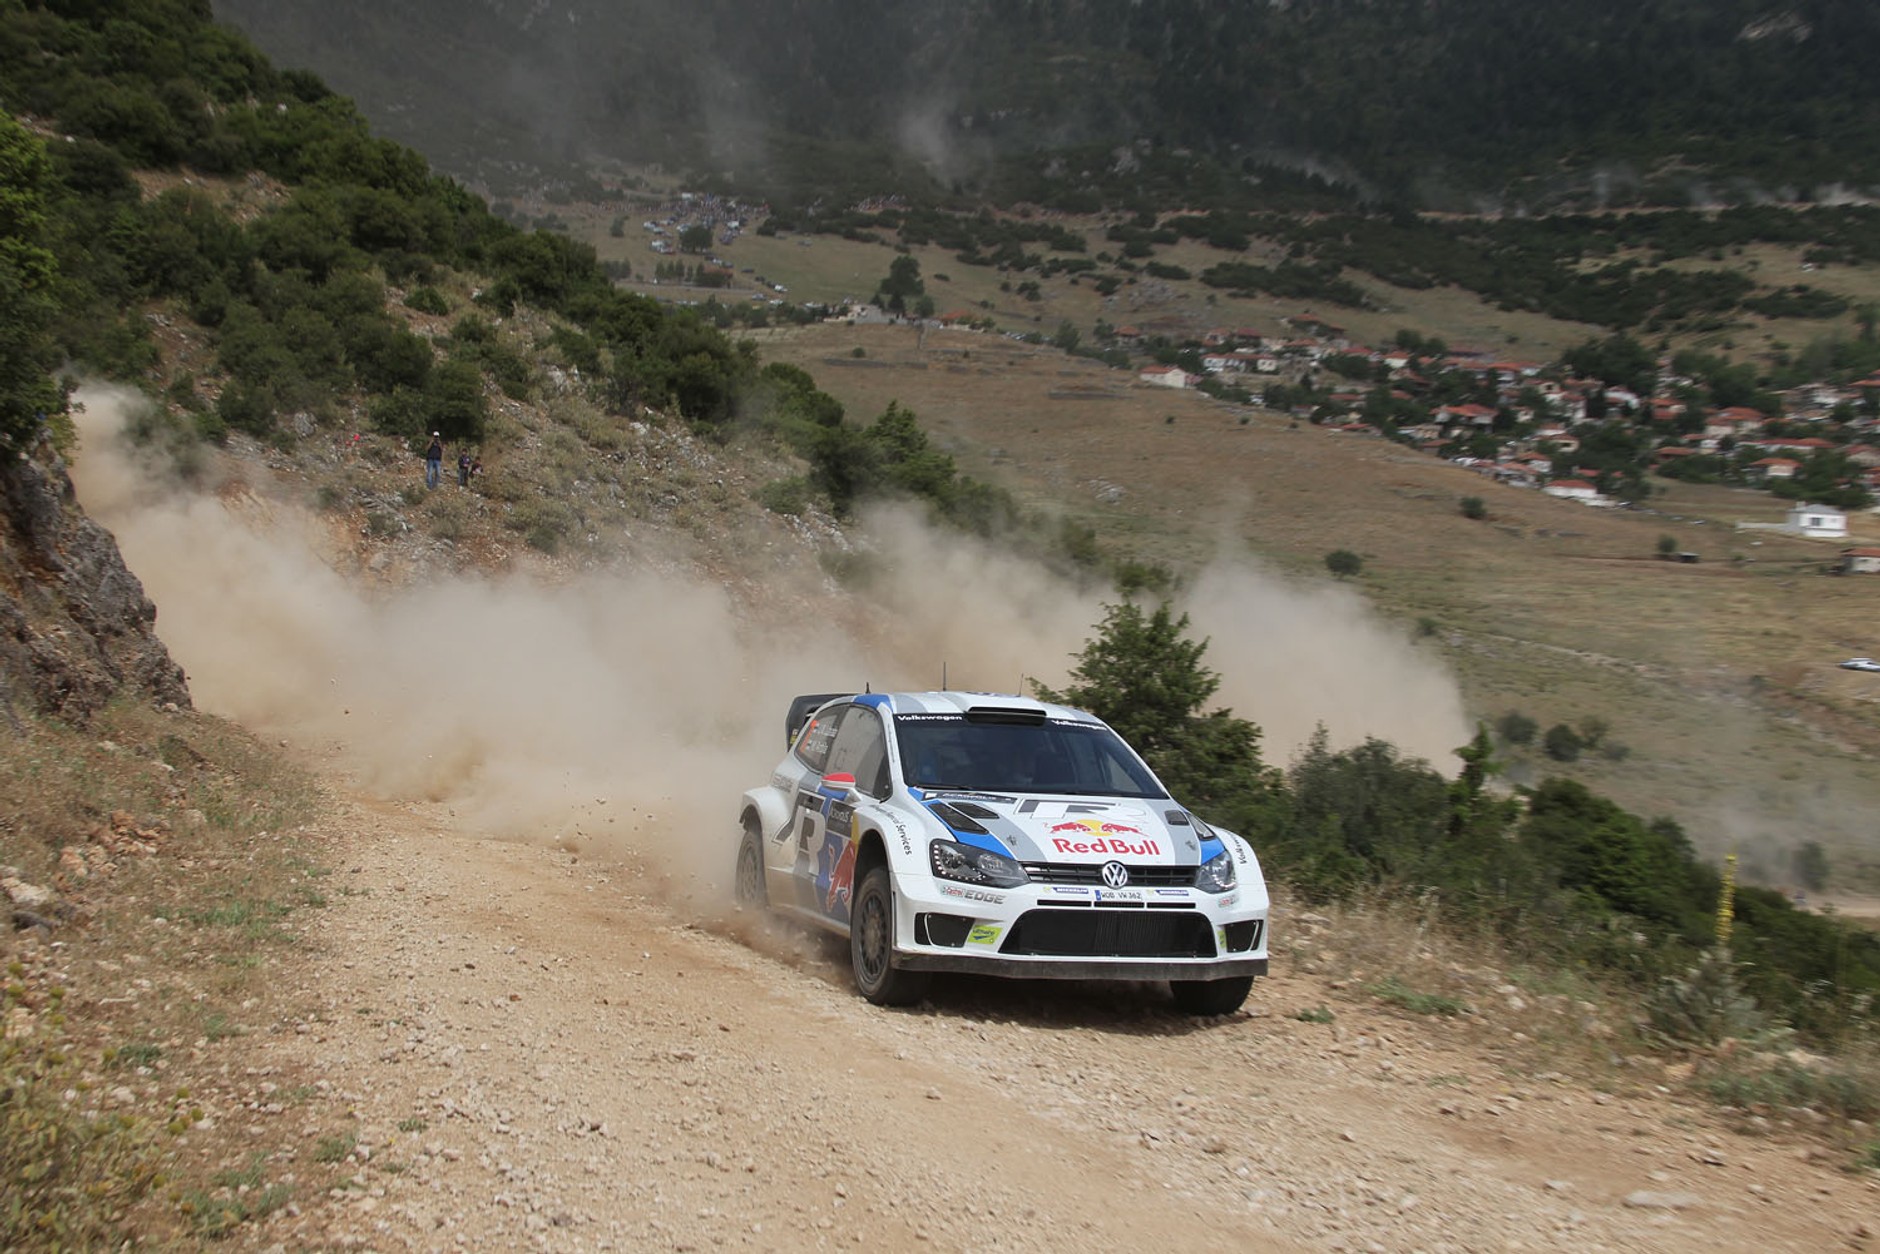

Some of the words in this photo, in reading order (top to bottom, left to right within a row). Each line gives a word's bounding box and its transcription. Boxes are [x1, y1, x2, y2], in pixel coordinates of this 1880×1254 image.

[895, 823, 913, 855] Services
[1052, 838, 1109, 853] Red
[1109, 839, 1161, 855] Bull
[965, 890, 1007, 904] EDGE
[1129, 892, 1142, 900] 362
